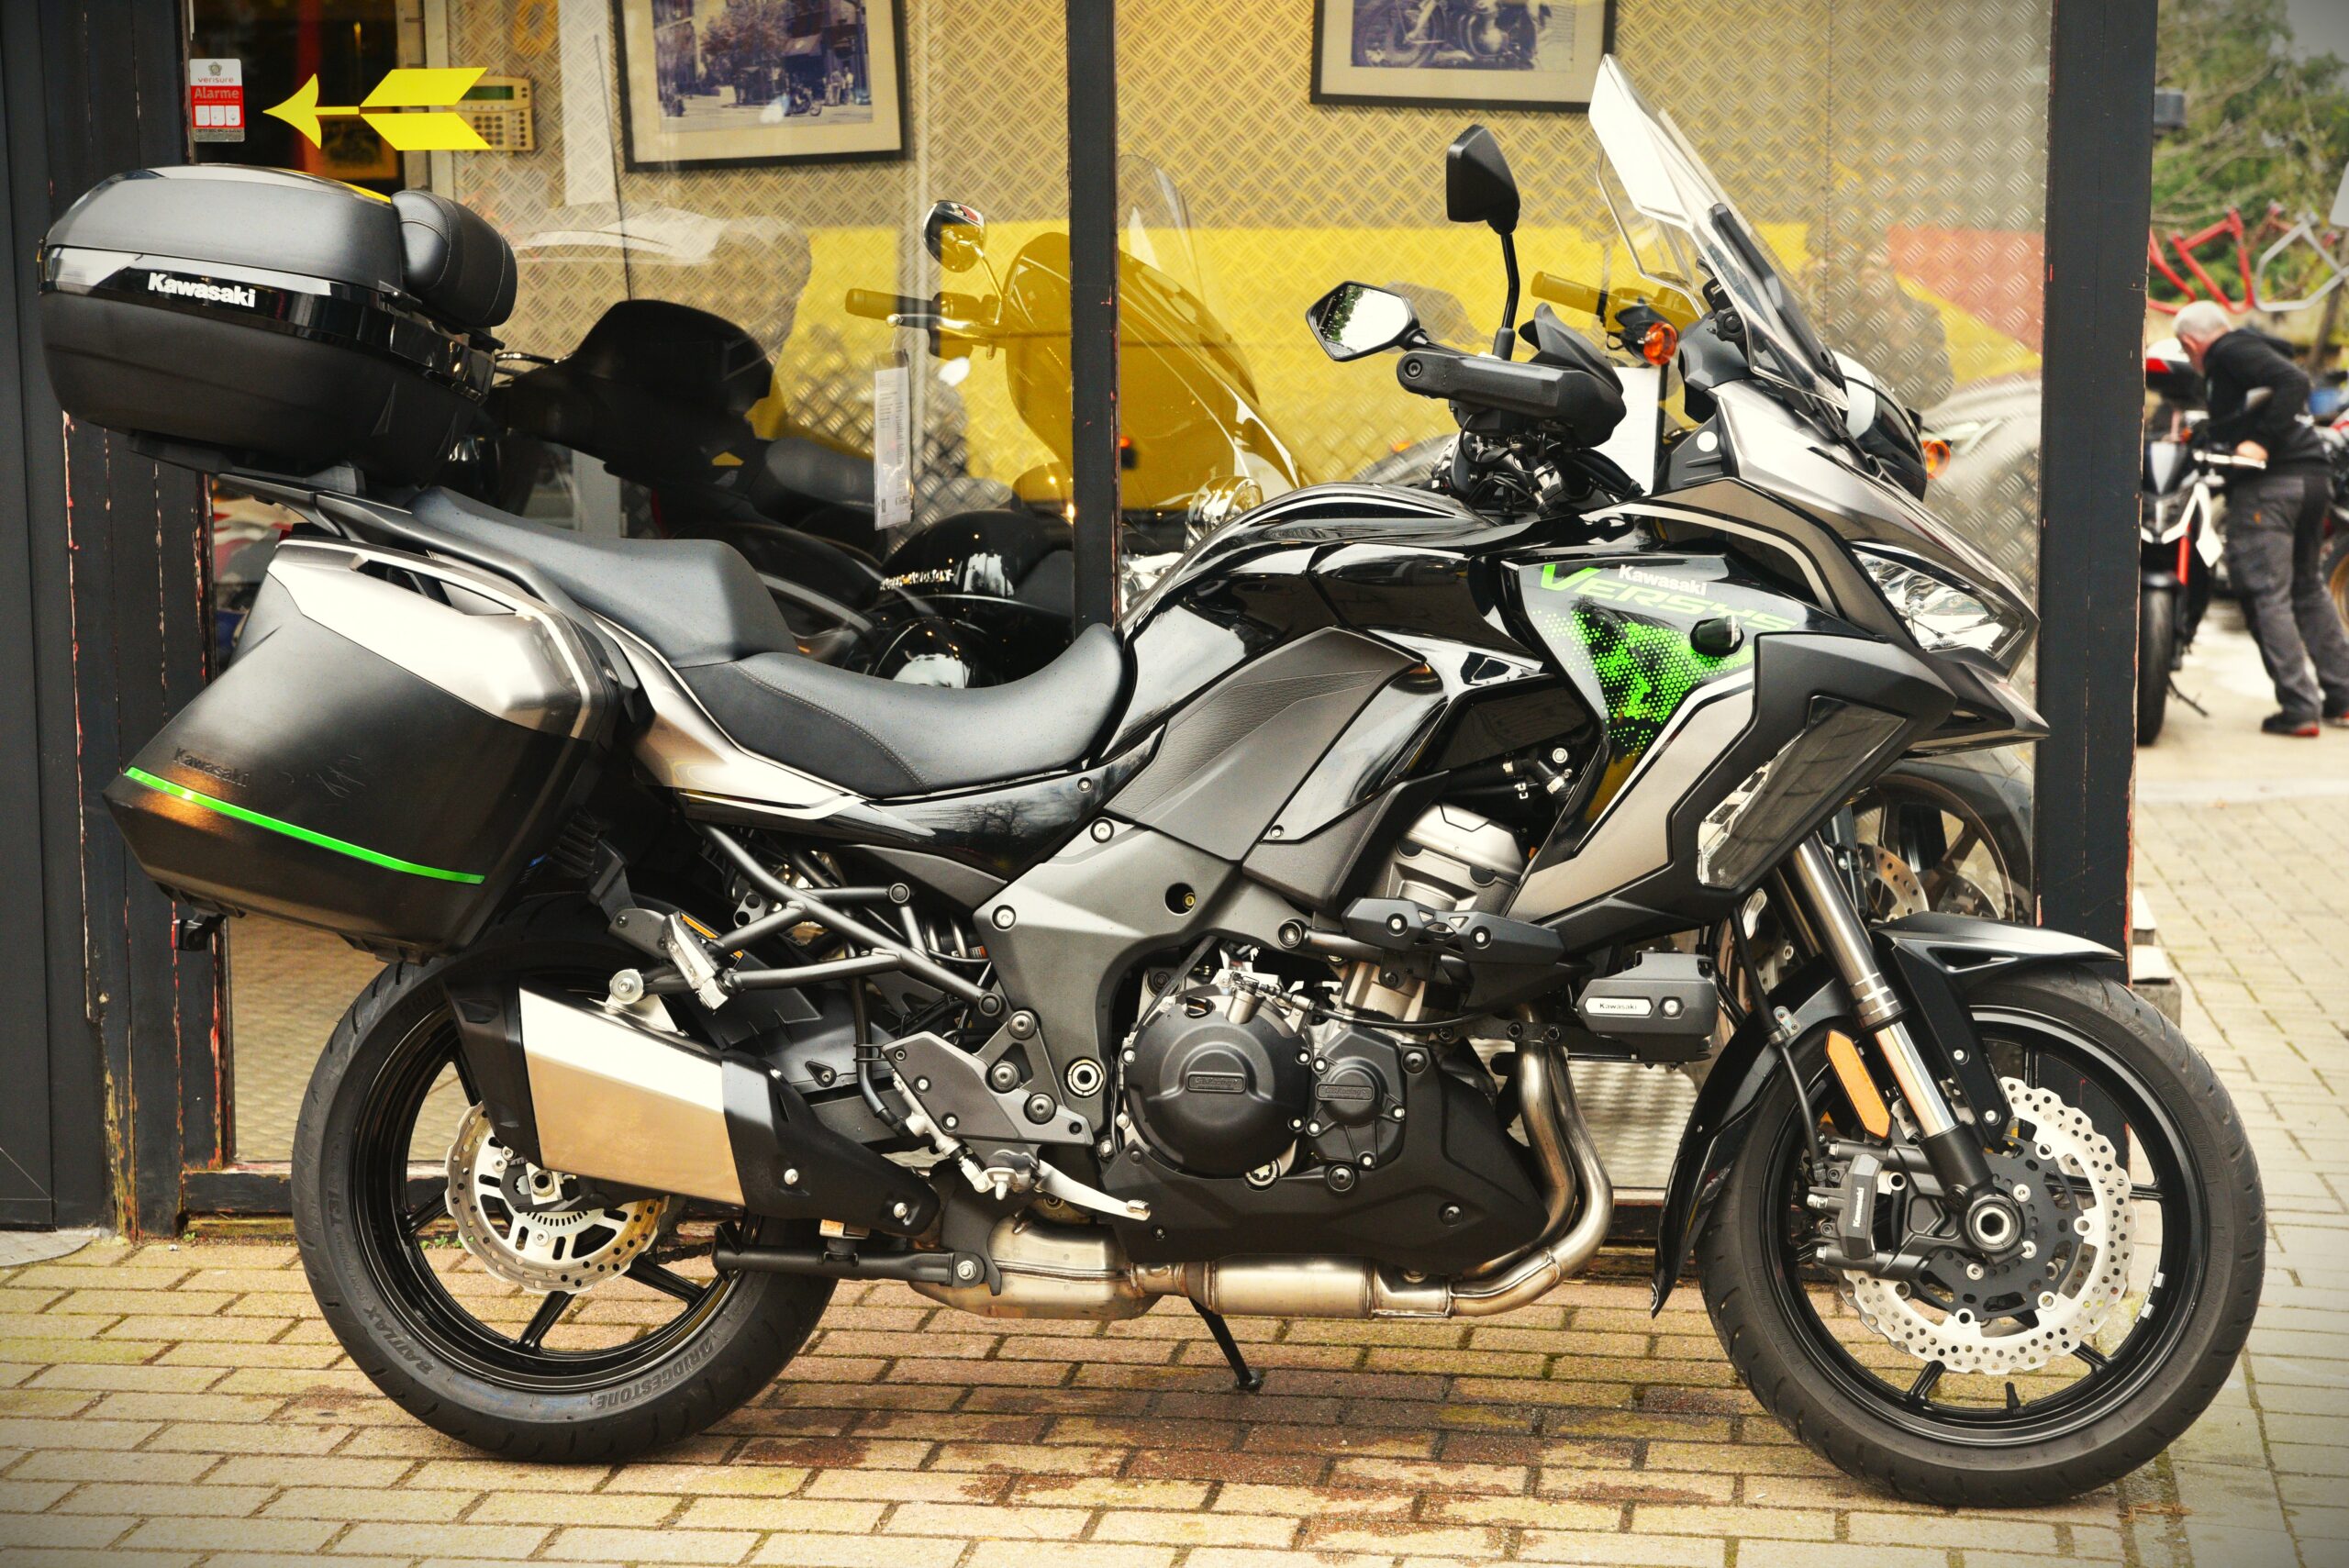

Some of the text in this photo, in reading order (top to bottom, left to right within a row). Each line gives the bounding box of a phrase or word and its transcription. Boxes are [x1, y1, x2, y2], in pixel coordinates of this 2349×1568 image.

[194, 86, 240, 99] Alarme
[148, 272, 256, 308] Kawasaki
[1540, 563, 1798, 631] VERSYS
[1618, 563, 1708, 597] Kawasaki
[172, 747, 250, 787] Kawasaki
[1599, 1002, 1637, 1010] Kawasaki
[1853, 1186, 1865, 1228] Kawasaki
[596, 1336, 715, 1410] BRIDGESTONE
